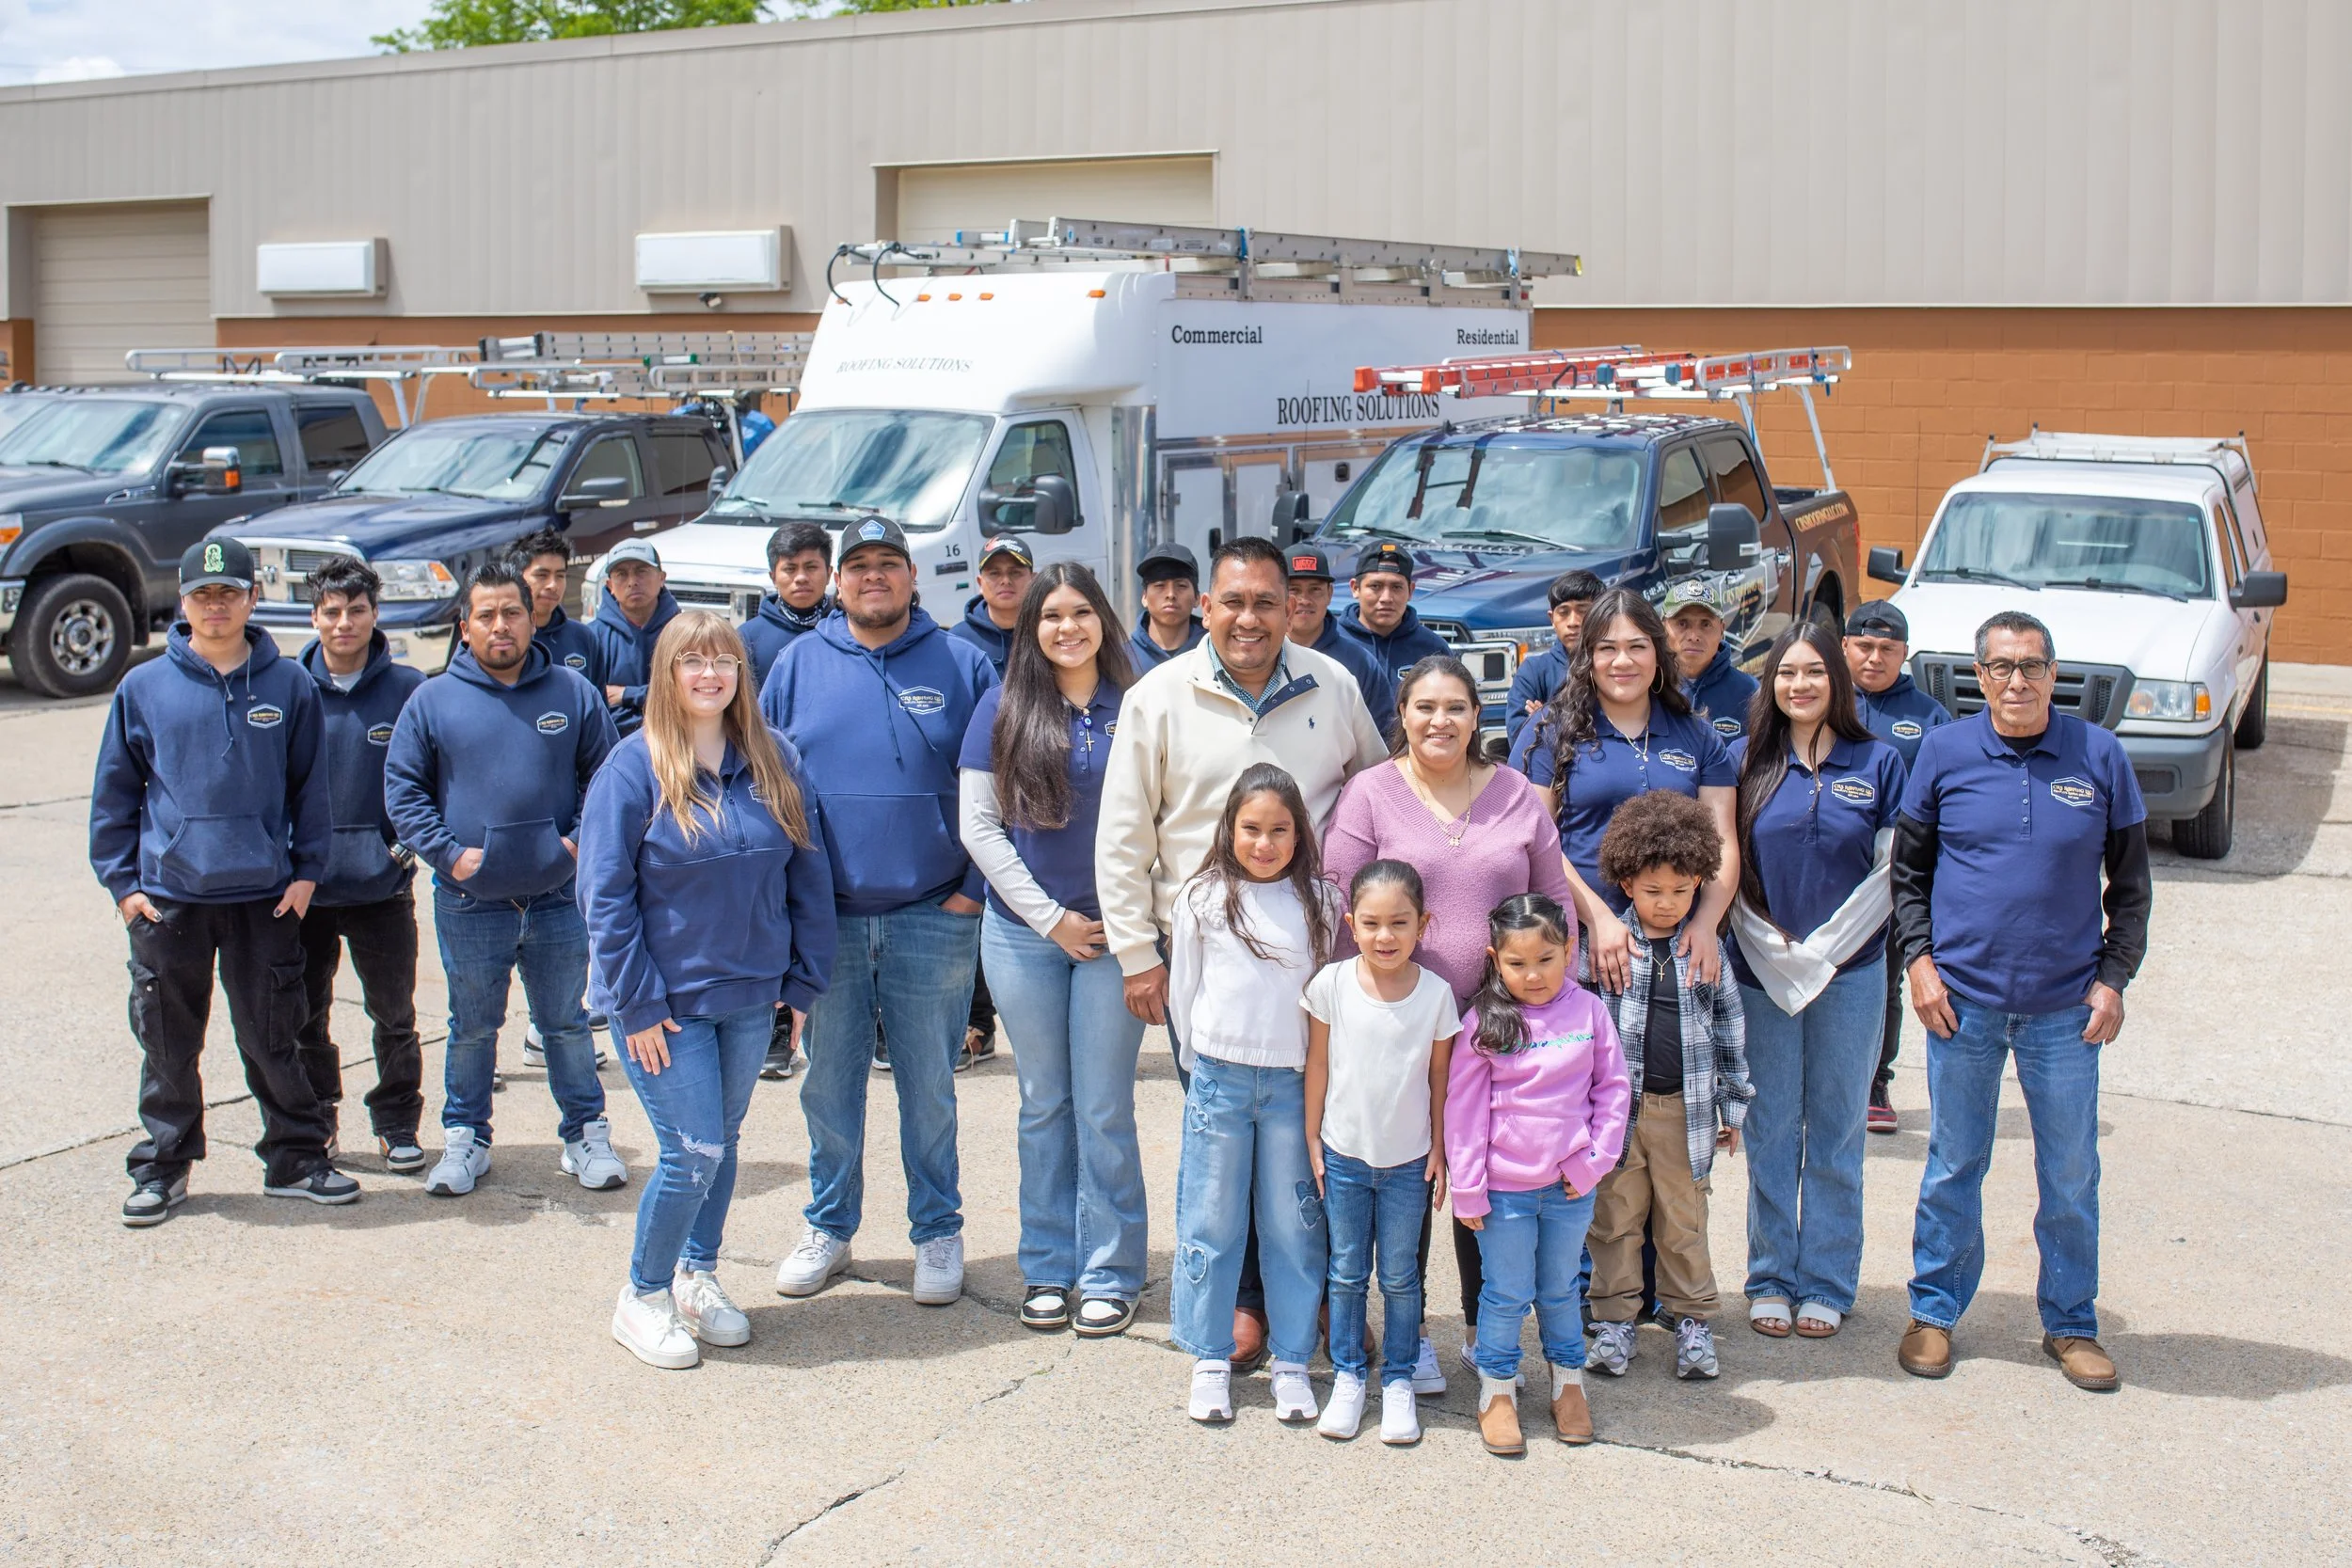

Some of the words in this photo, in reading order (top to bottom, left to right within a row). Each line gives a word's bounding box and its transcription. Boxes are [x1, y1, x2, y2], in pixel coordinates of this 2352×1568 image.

[1171, 325, 1263, 344] Commercial
[1456, 328, 1519, 345] Residential
[836, 356, 893, 373] ROOFING
[894, 356, 973, 373] SOLUTIONS
[1277, 395, 1352, 425] ROOFING
[1356, 393, 1440, 422] SOLUTIONS
[946, 544, 961, 557] 16
